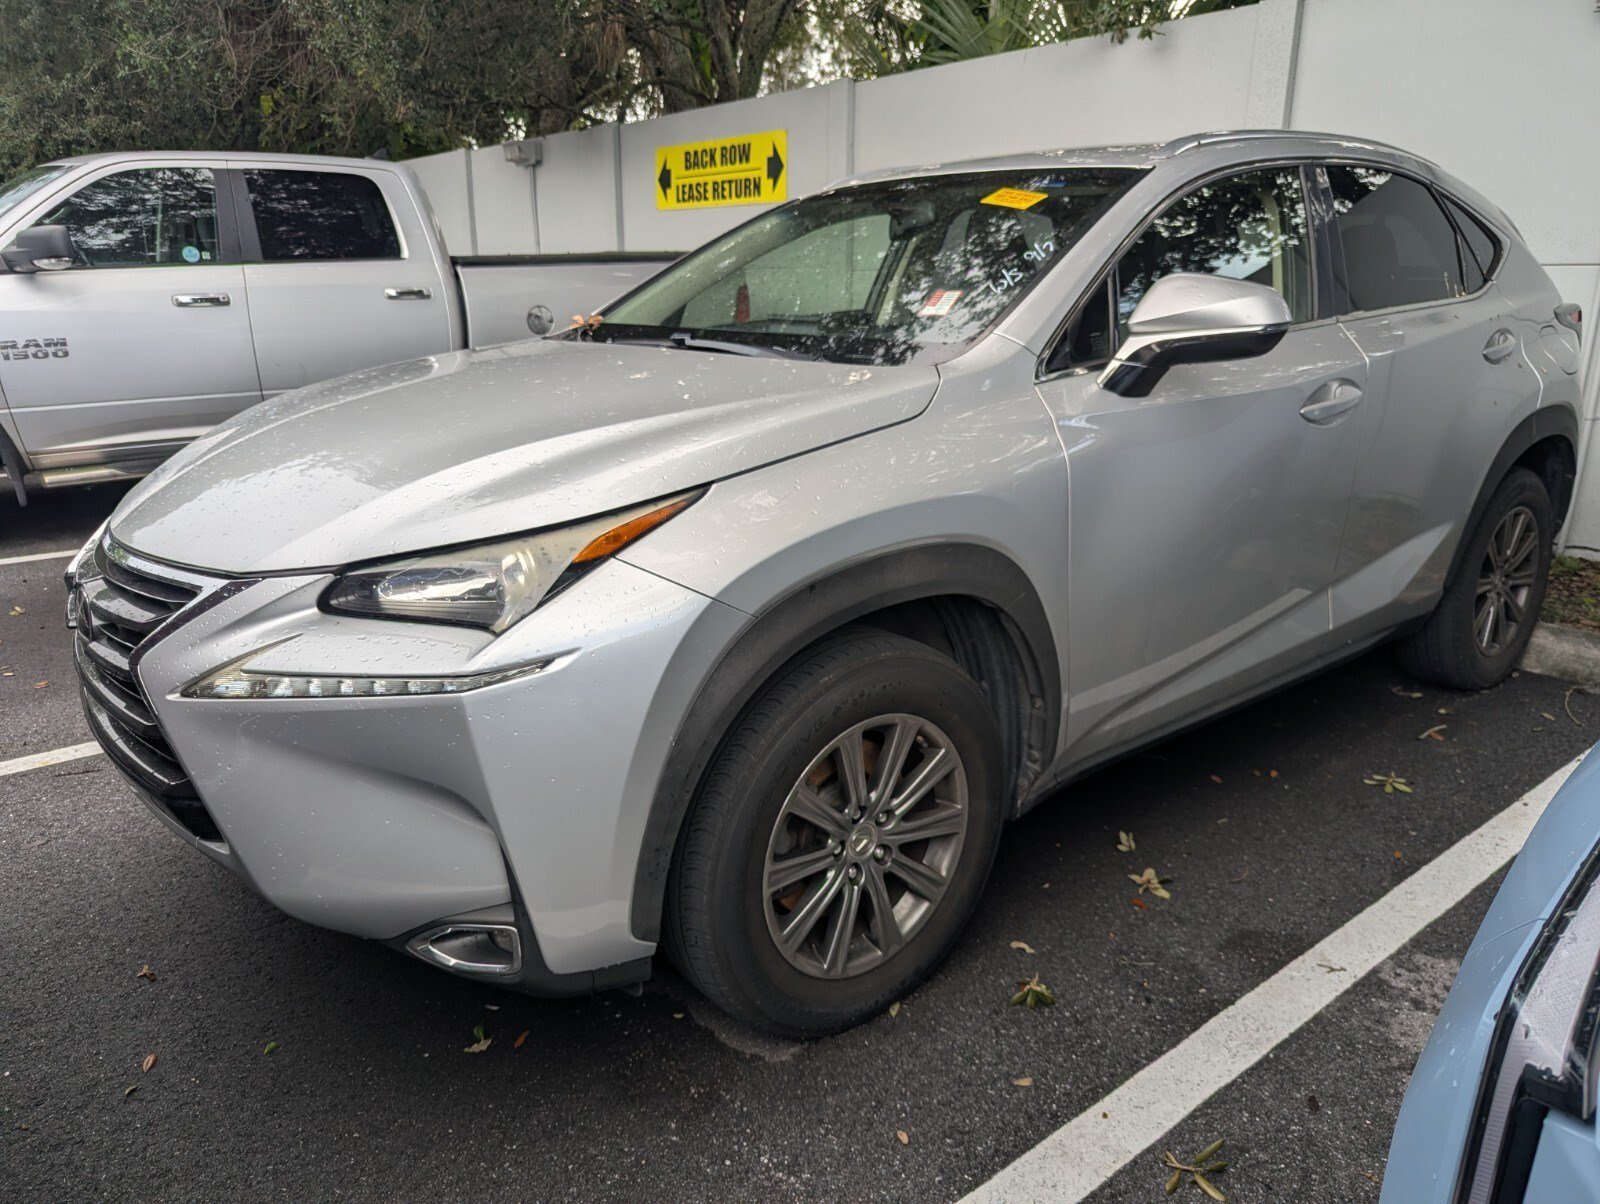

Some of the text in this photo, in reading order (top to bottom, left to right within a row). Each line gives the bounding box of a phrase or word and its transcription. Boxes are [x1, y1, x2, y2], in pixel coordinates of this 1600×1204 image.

[684, 142, 751, 171] BACK ROW
[676, 176, 761, 203] LEASE RETURN
[0, 337, 67, 349] RAM
[0, 348, 69, 360] 1500
